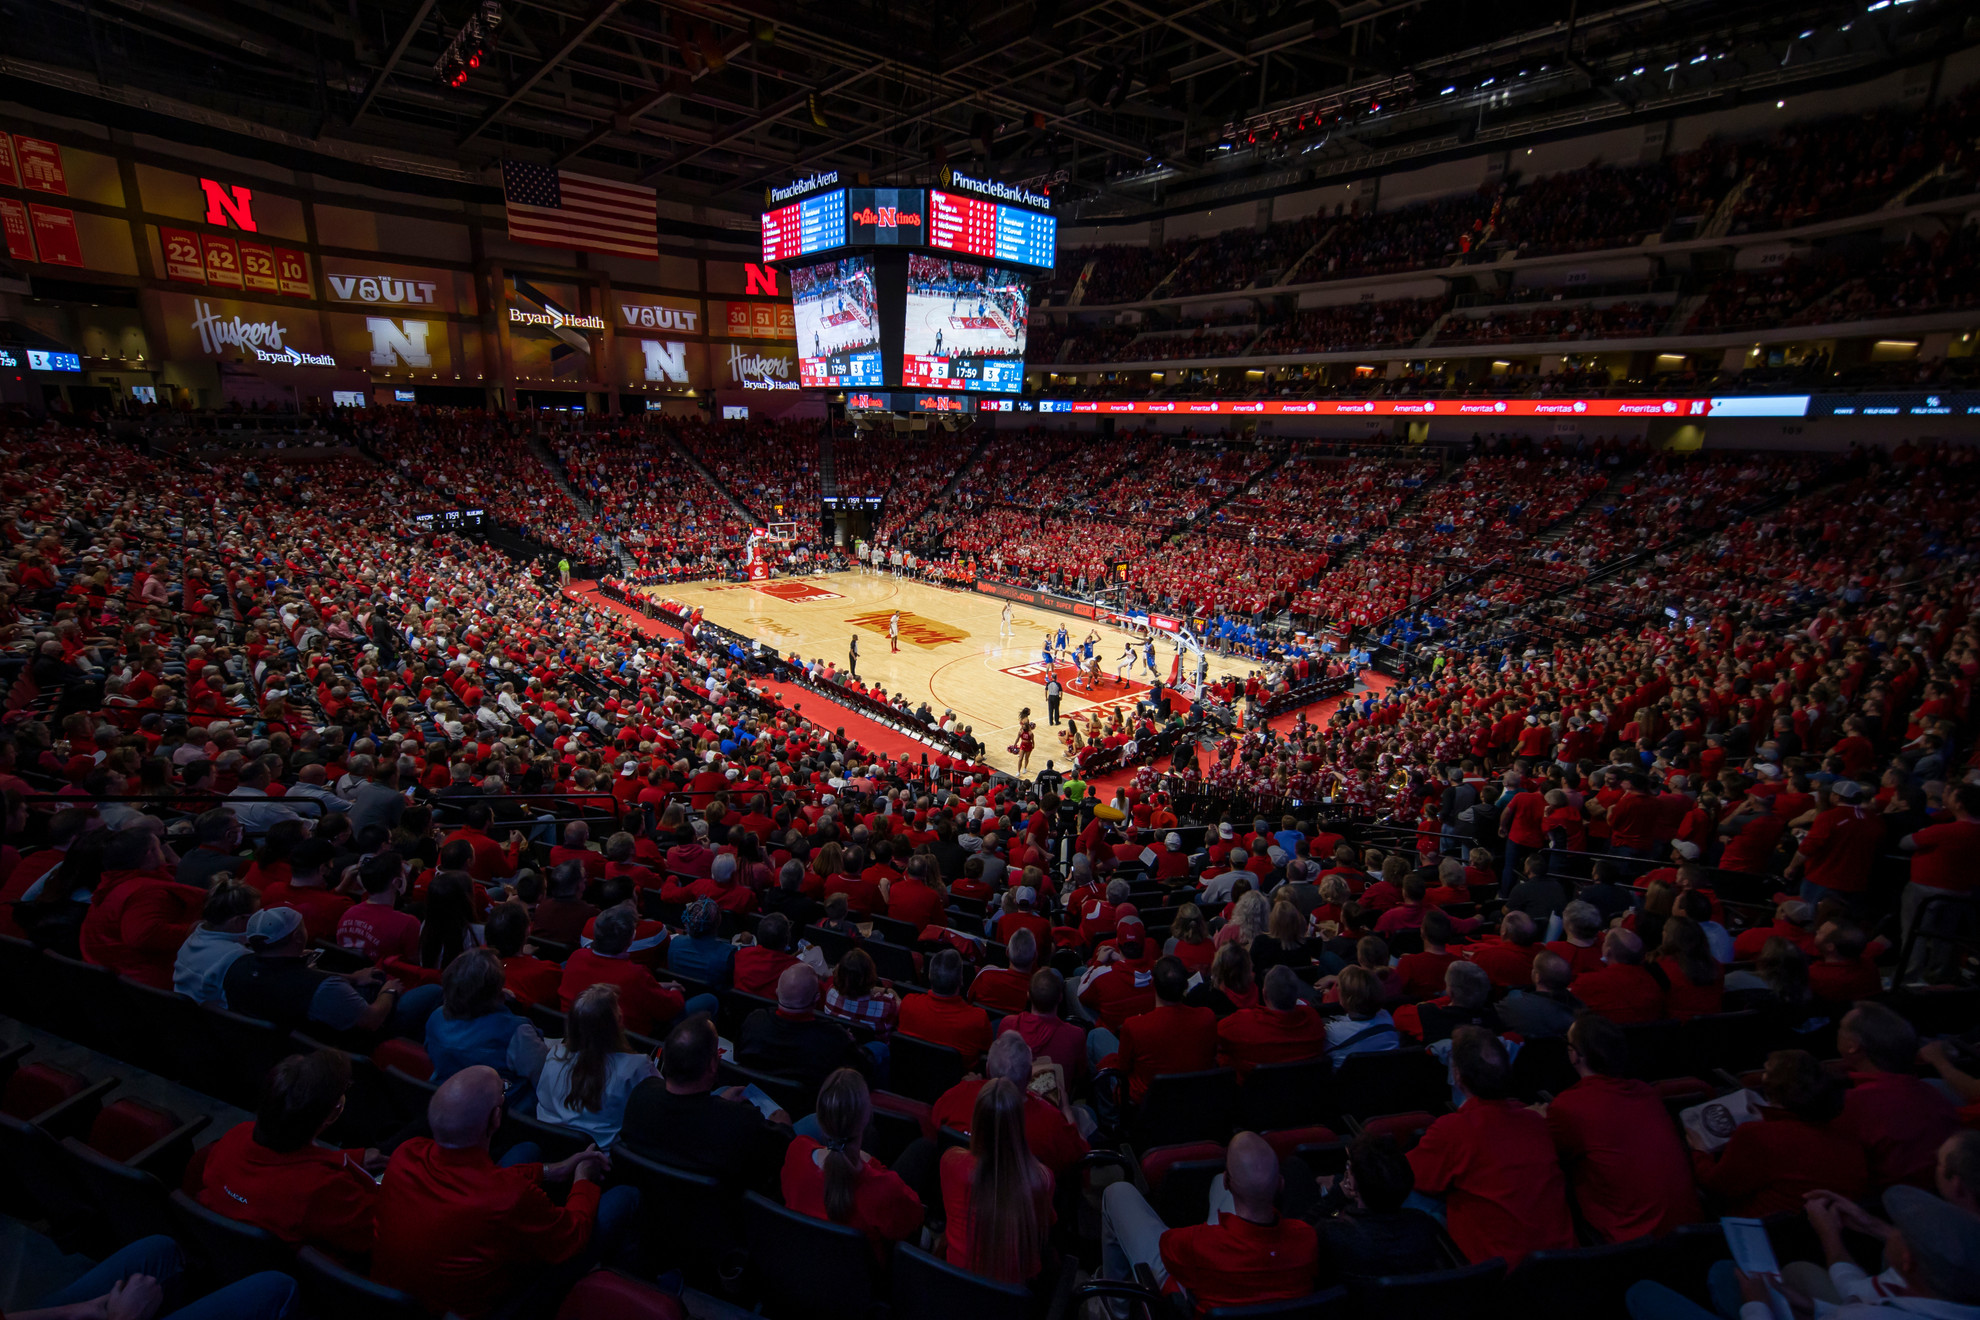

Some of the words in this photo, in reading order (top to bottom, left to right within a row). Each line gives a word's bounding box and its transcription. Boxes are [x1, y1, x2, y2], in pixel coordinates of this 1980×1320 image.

[816, 171, 837, 188] Arena
[199, 177, 258, 232] N
[1022, 189, 1050, 209] Arena
[168, 243, 198, 264] 22
[207, 250, 235, 269] 42
[246, 256, 272, 275] 52
[282, 261, 302, 279] 10
[209, 271, 218, 279] N
[247, 277, 255, 285] N
[744, 263, 778, 296] N
[509, 308, 551, 326] Bryan
[564, 314, 605, 329] Health
[731, 312, 746, 324] 30
[756, 313, 770, 325] 51
[780, 314, 794, 326] 23
[192, 298, 287, 354] Huskers
[366, 317, 432, 368] N
[34, 354, 42, 366] 3
[256, 349, 292, 365] Bryan
[301, 353, 336, 366] Health
[640, 340, 689, 383] N
[727, 343, 794, 382] Huskers
[919, 364, 928, 375] N
[938, 366, 943, 376] 5
[957, 367, 977, 378] 17:59
[988, 370, 993, 379] 3
[744, 380, 768, 390] Bryan
[775, 381, 800, 390] Health
[1690, 401, 1705, 414] N
[1926, 396, 1941, 407] %
[1282, 404, 1306, 412] Ameritas
[1336, 404, 1364, 412] Ameritas
[1394, 404, 1424, 412] Ameritas
[1460, 404, 1493, 413] Ameritas
[1535, 404, 1572, 413] Ameritas
[1618, 404, 1661, 413] Ameritas
[1782, 426, 1802, 434] 109
[1120, 570, 1126, 581] 9
[1044, 598, 1054, 606] GET
[1056, 600, 1071, 610] SUPER
